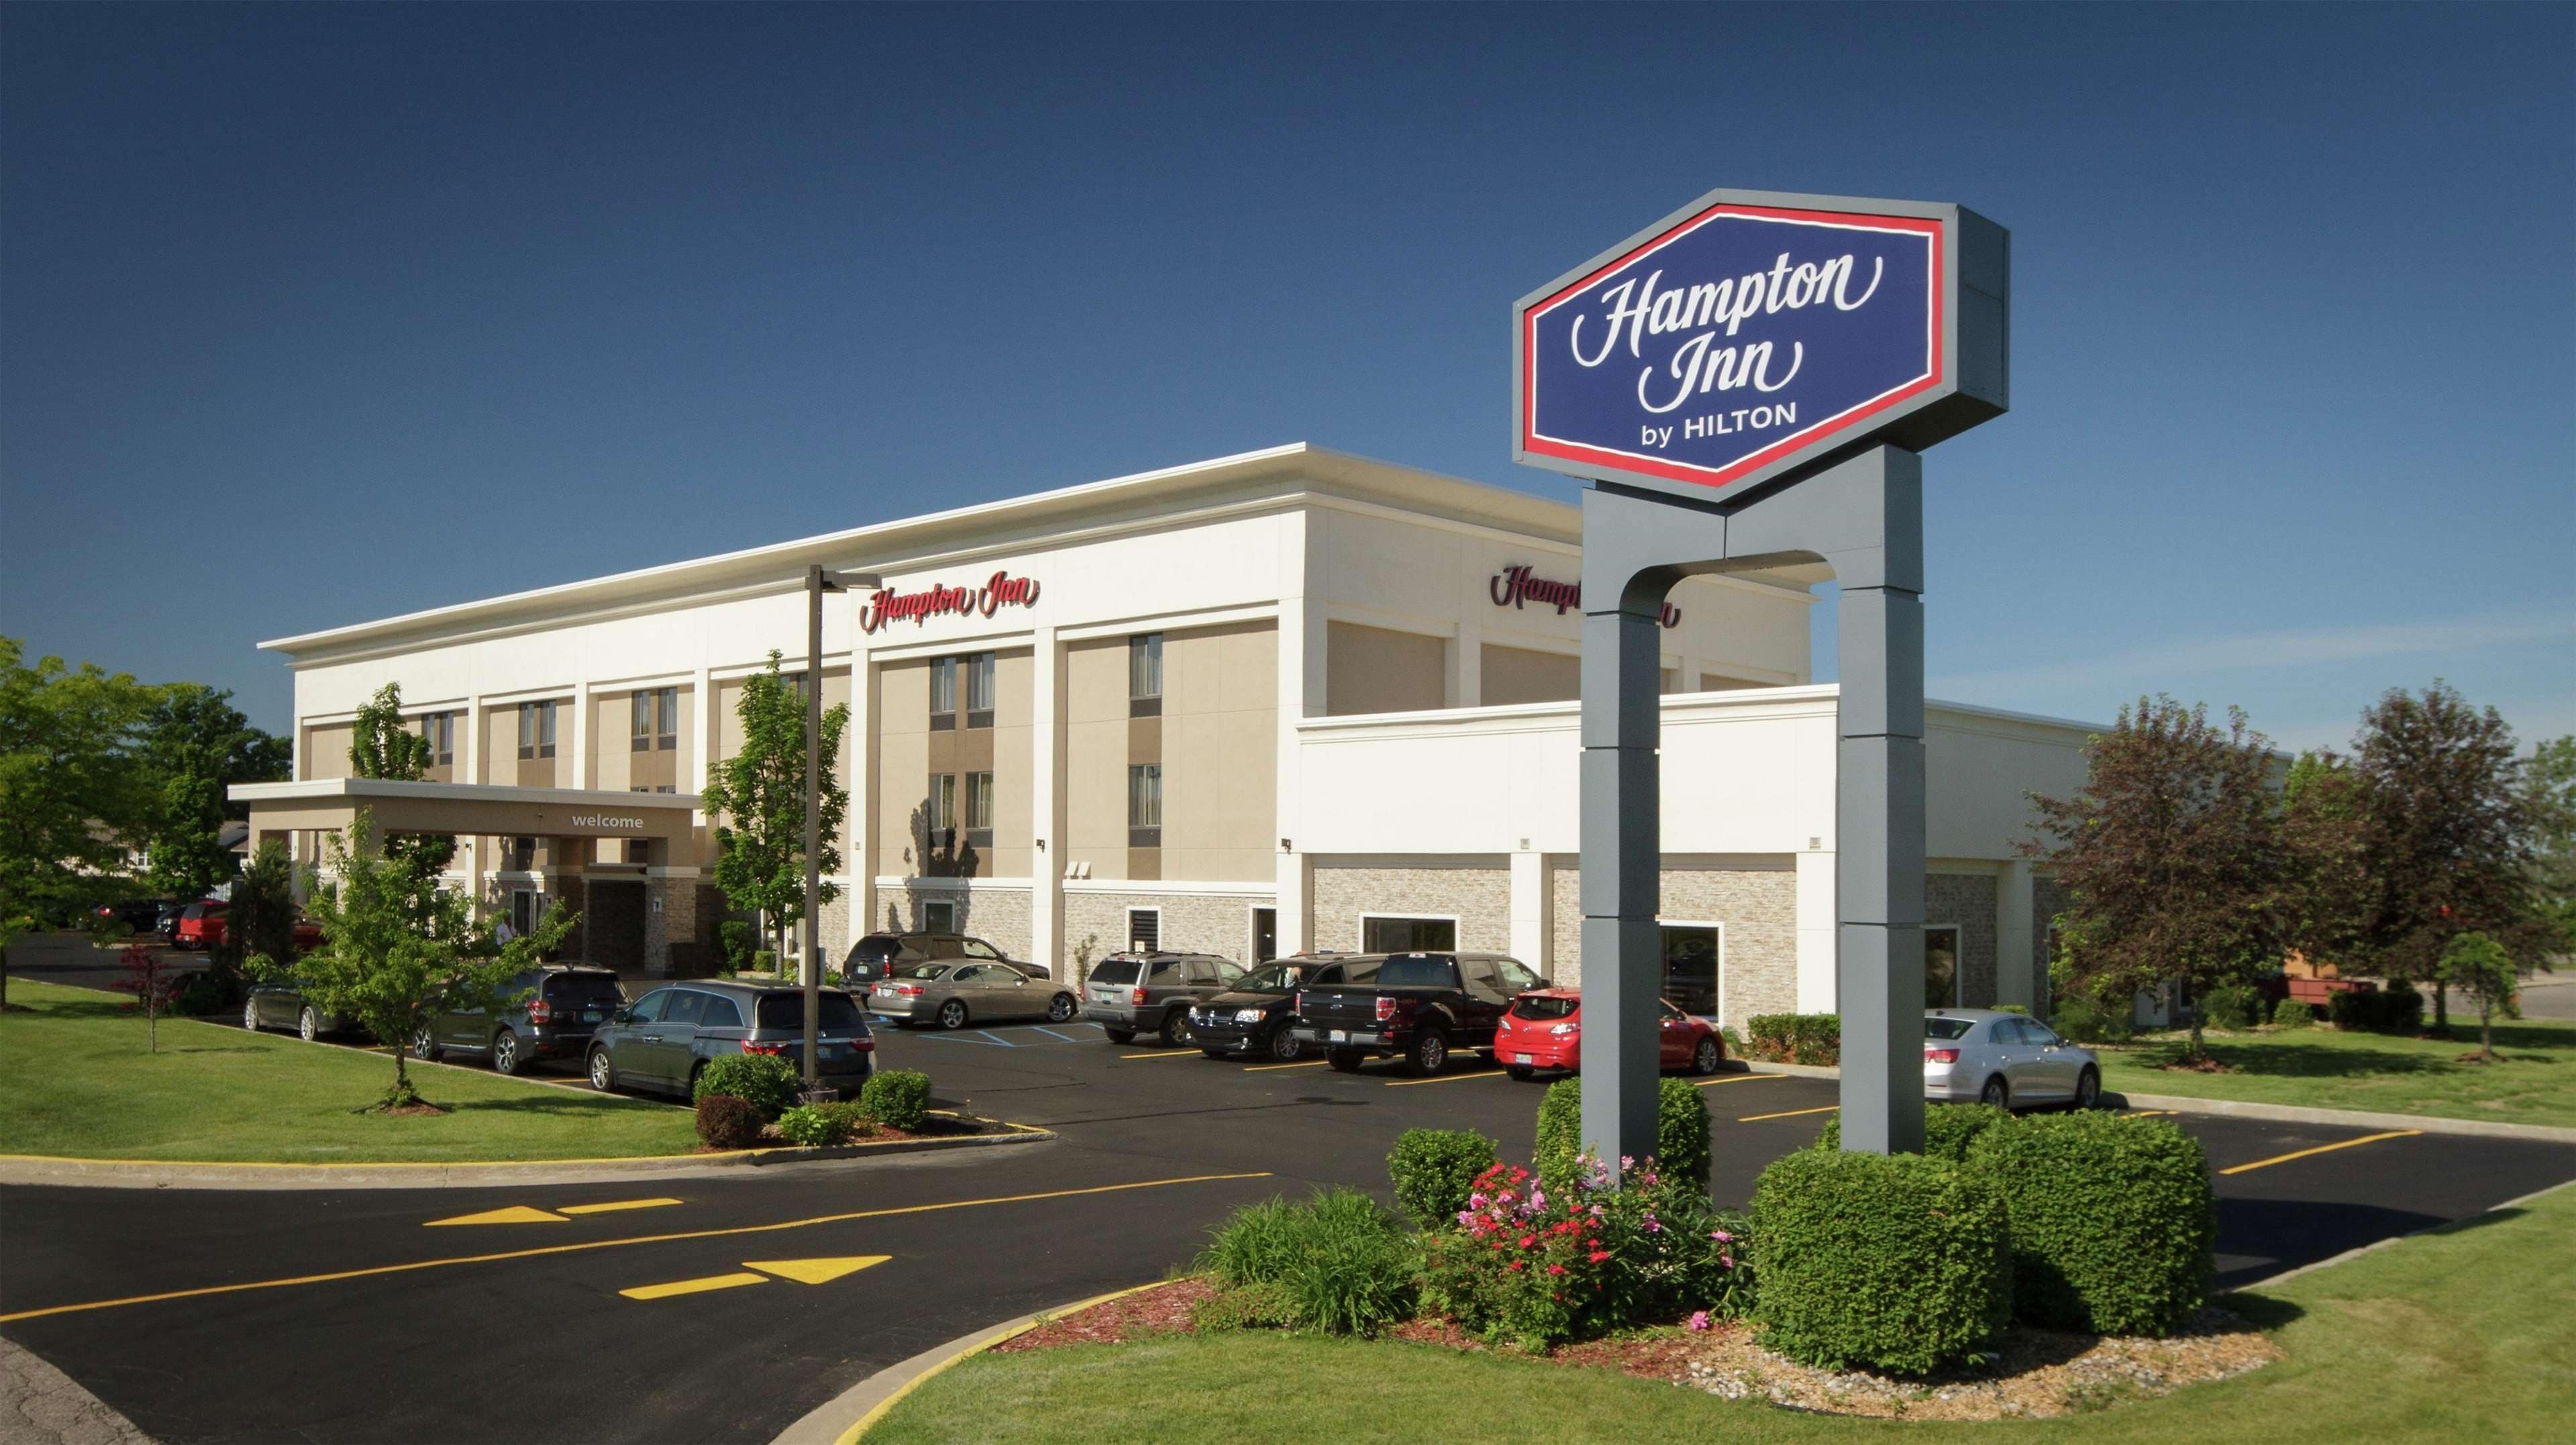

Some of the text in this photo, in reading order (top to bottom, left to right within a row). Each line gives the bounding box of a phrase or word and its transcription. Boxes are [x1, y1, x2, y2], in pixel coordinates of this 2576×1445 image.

[1571, 252, 1883, 367] Hampton
[1638, 331, 1803, 413] Inn
[1641, 403, 1796, 448] by HILTON
[860, 571, 1040, 632] Hampton Inn
[1490, 566, 1581, 614] Hamp
[572, 813, 644, 828] welcome
